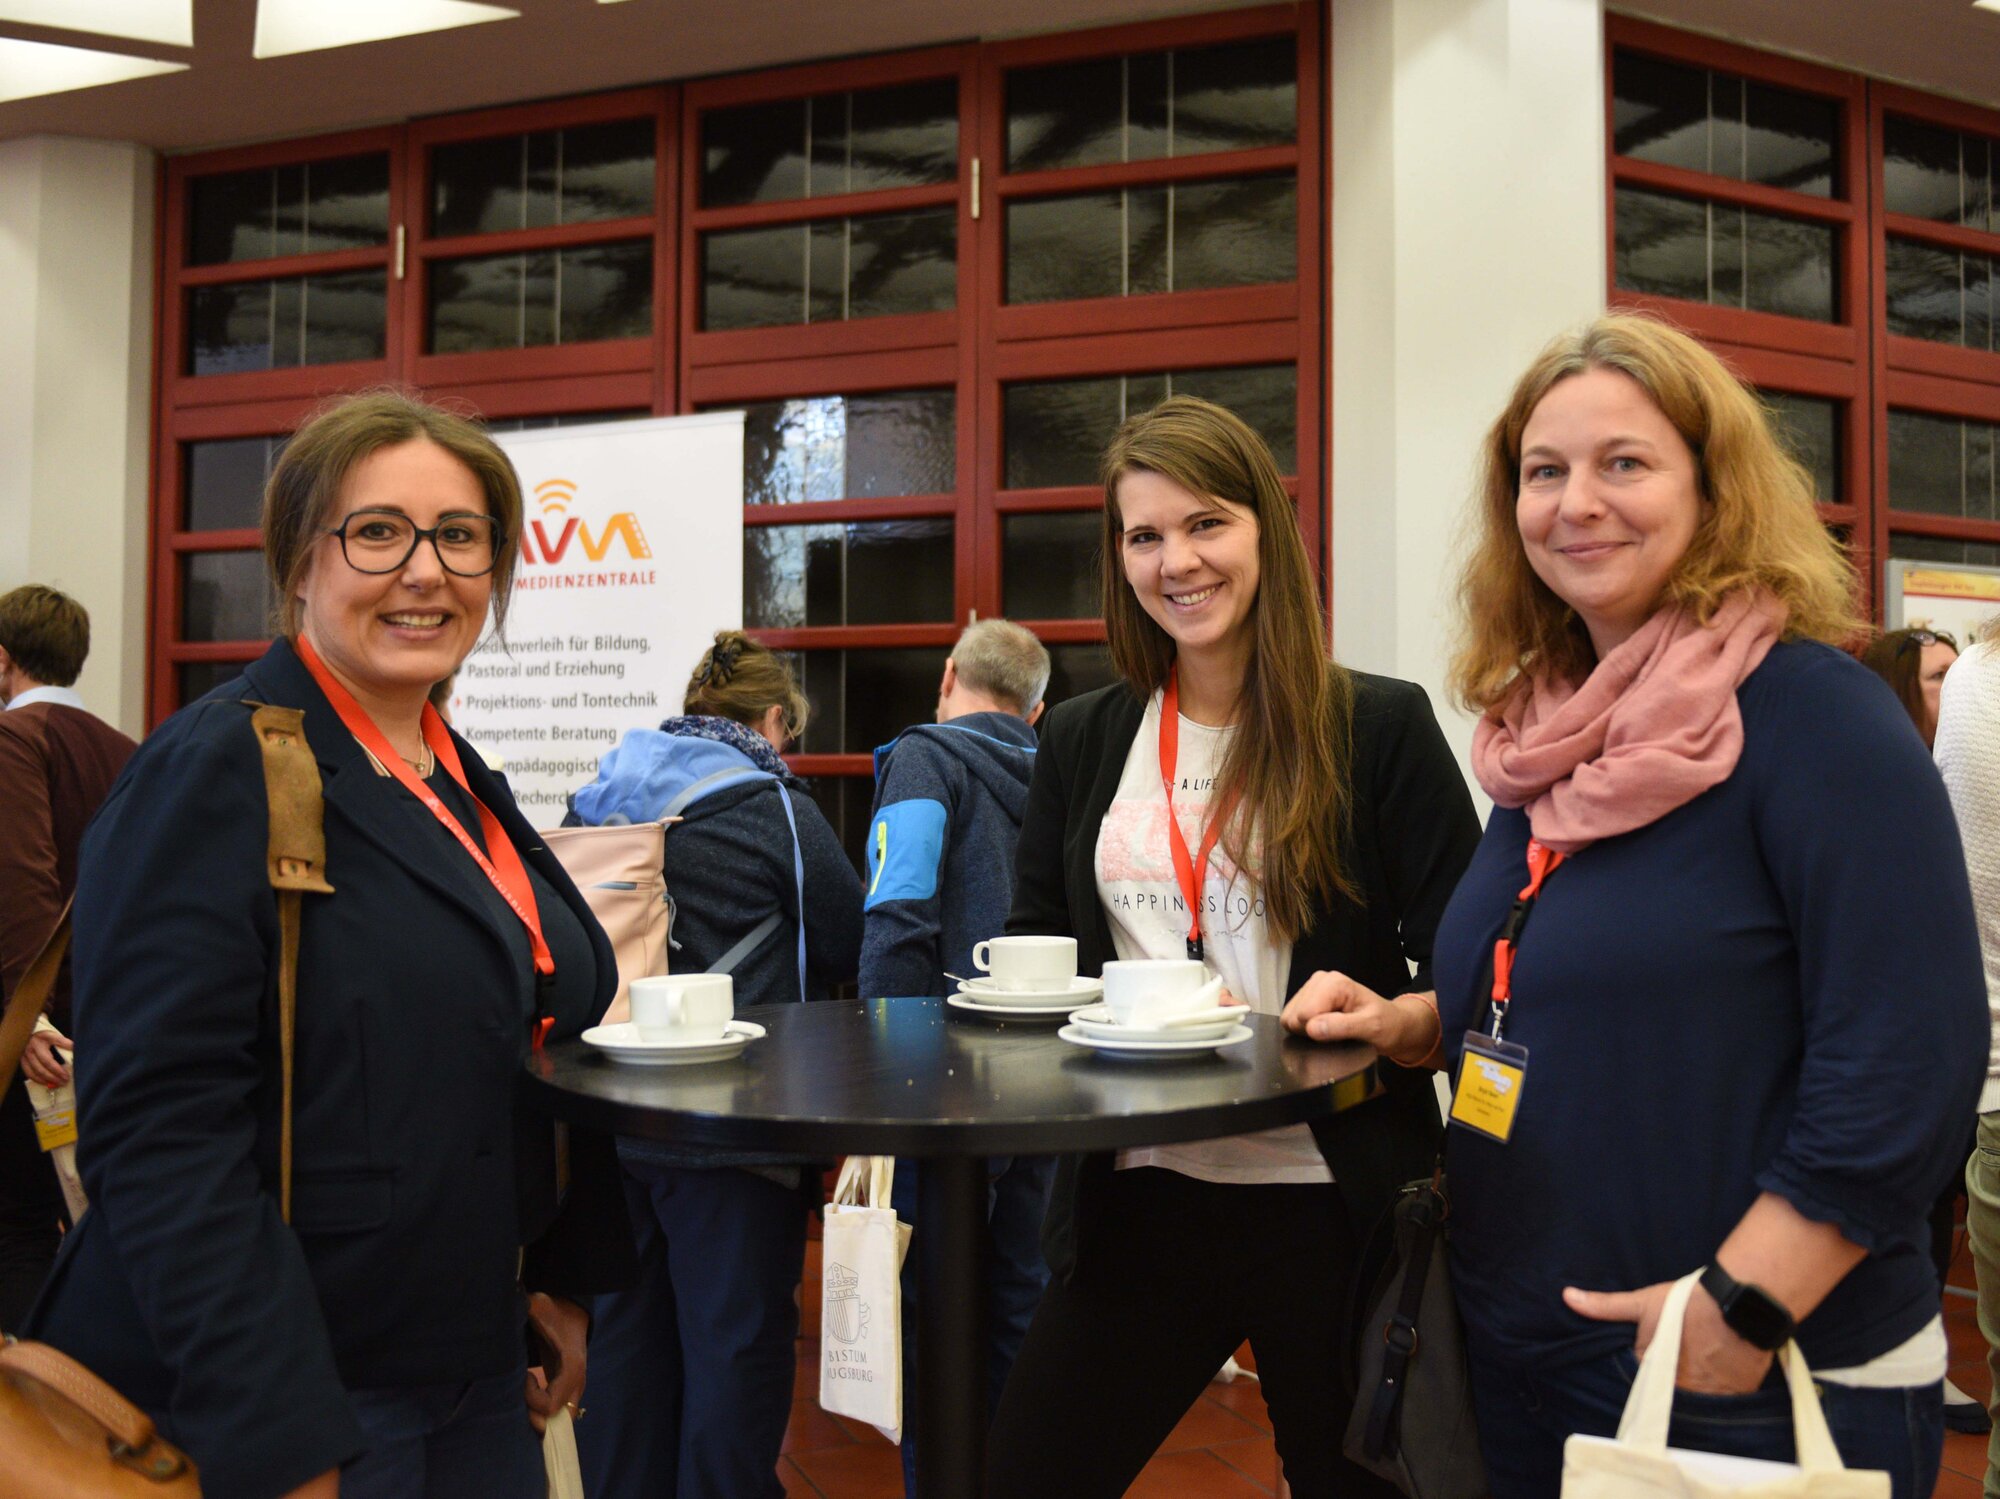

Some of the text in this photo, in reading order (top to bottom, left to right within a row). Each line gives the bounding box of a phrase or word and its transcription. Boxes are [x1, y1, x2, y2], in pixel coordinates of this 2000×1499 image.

[569, 635, 590, 650] für
[594, 635, 651, 653] Bildung,
[468, 660, 625, 679] Pastoral und Erziehung
[466, 691, 658, 713] Projektions- und Tontechnik
[466, 726, 617, 744] Kompetente Beratung
[1181, 778, 1188, 790] A
[1113, 893, 1216, 913] HAPPINSS
[829, 1350, 867, 1364] BISTUM
